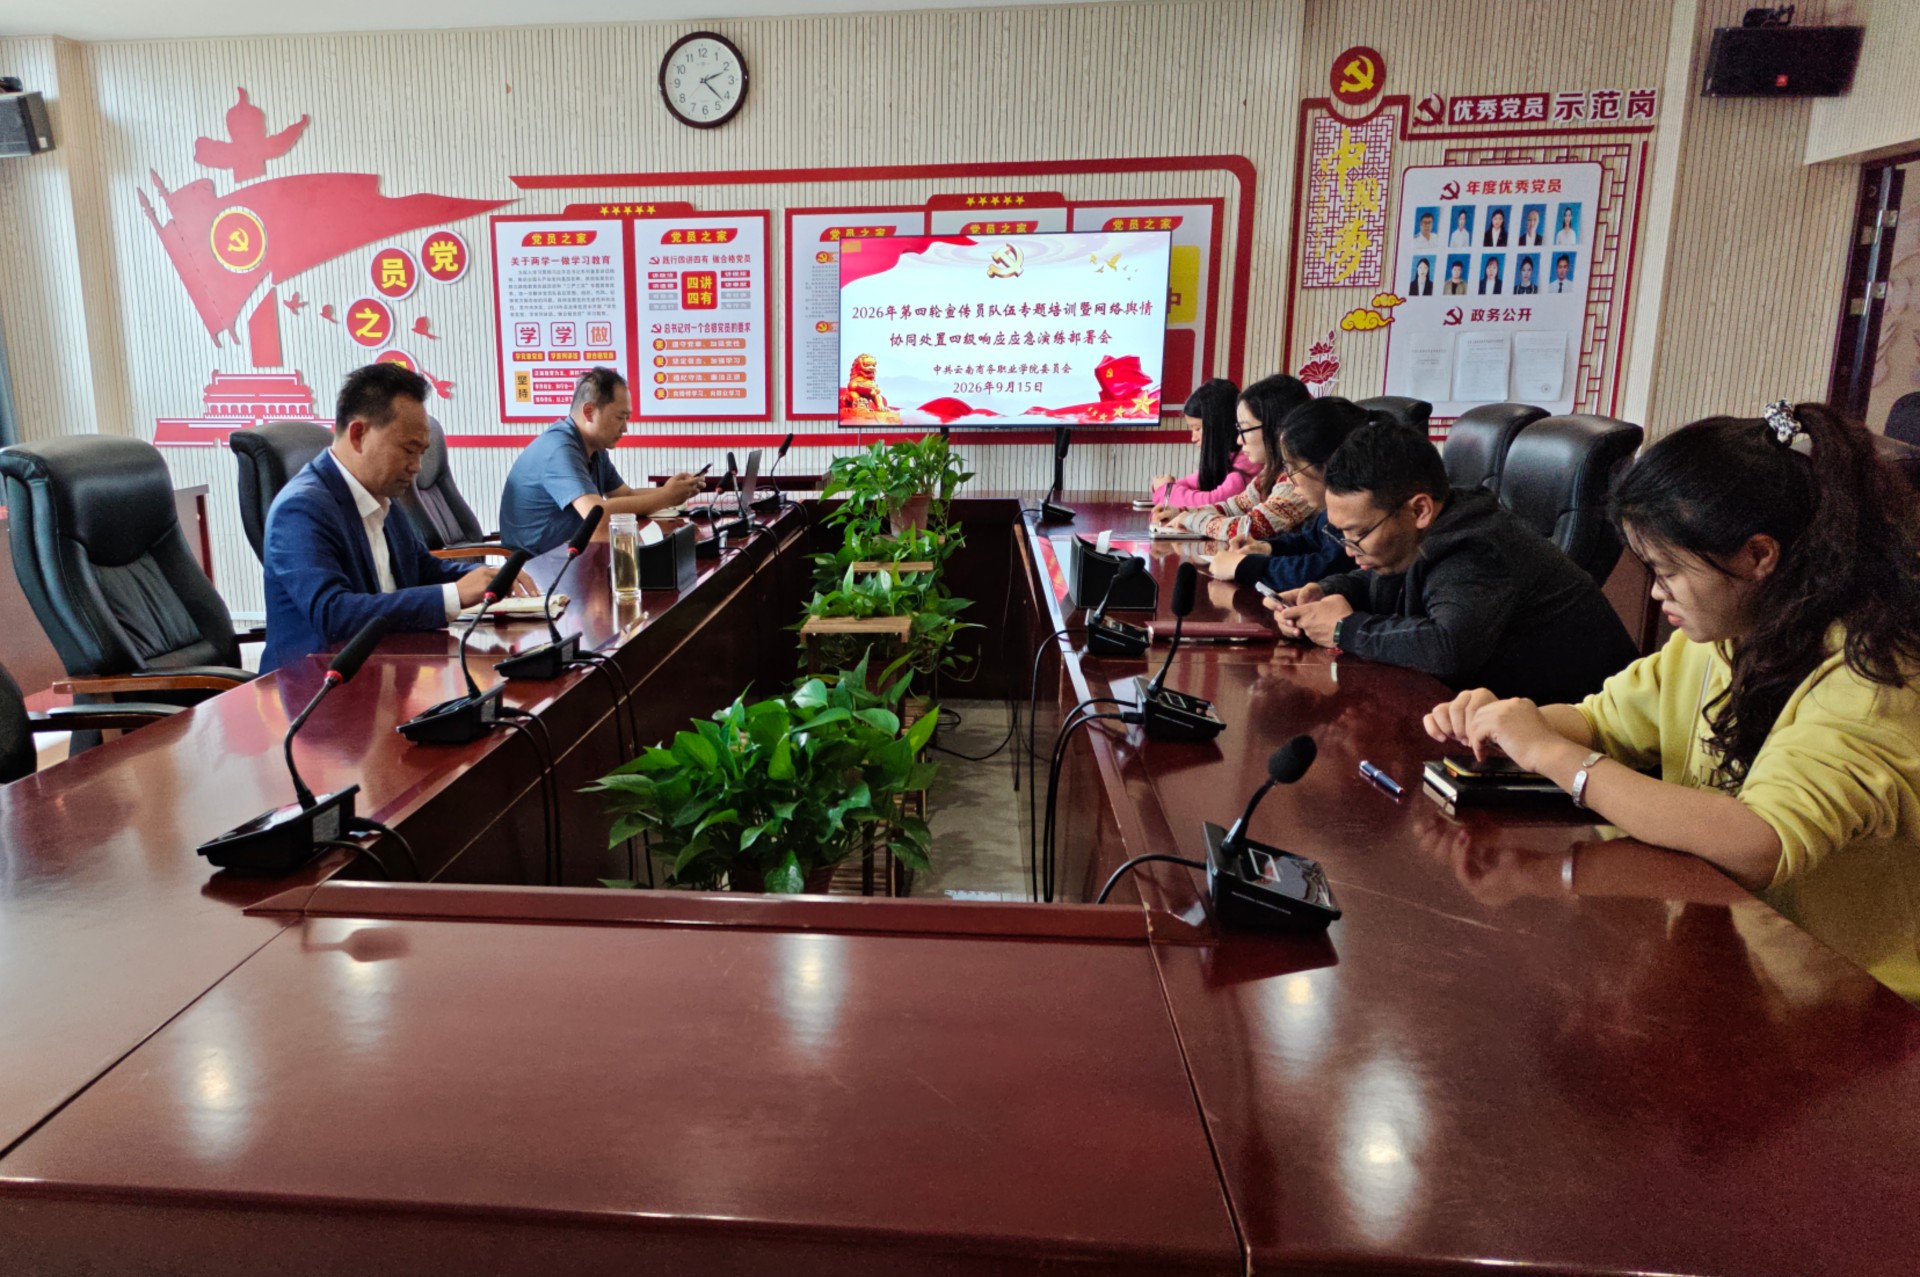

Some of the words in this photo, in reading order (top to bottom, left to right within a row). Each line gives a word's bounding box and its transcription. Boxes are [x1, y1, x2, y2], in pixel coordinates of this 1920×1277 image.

[686, 53, 693, 63] 11
[698, 48, 707, 58] 12
[715, 52, 718, 61] 1
[677, 64, 686, 75] 10
[723, 61, 730, 71] 2
[674, 78, 681, 88] 9
[728, 75, 735, 85] 3
[679, 93, 686, 103] 8
[724, 90, 730, 100] 4
[690, 102, 697, 112] 7
[702, 105, 709, 115] 6
[715, 101, 721, 110] 5
[1453, 97, 1546, 122] 优秀党员
[1554, 89, 1657, 122] 示范岗
[1466, 178, 1562, 196] 年度优秀党员
[1112, 218, 1172, 231] 党员之家
[531, 233, 587, 245] 党员之家
[671, 230, 727, 243] 党员之家
[511, 256, 611, 266] 关于两学一做学习教育
[687, 276, 712, 290] 四讲
[687, 291, 712, 305] 四有
[852, 300, 1153, 321] 2026年第四轮宣传员队伍专题培训暨网络舆情
[1470, 307, 1532, 322] 政务公开
[520, 327, 537, 343] 学
[555, 326, 572, 343] 学
[591, 326, 608, 343] 做
[890, 329, 1112, 347] 协同处置四级响应应急演练部署会
[933, 363, 1072, 376] 中共云南商务职业学院委员会
[953, 381, 1043, 395] 2026年9月15日
